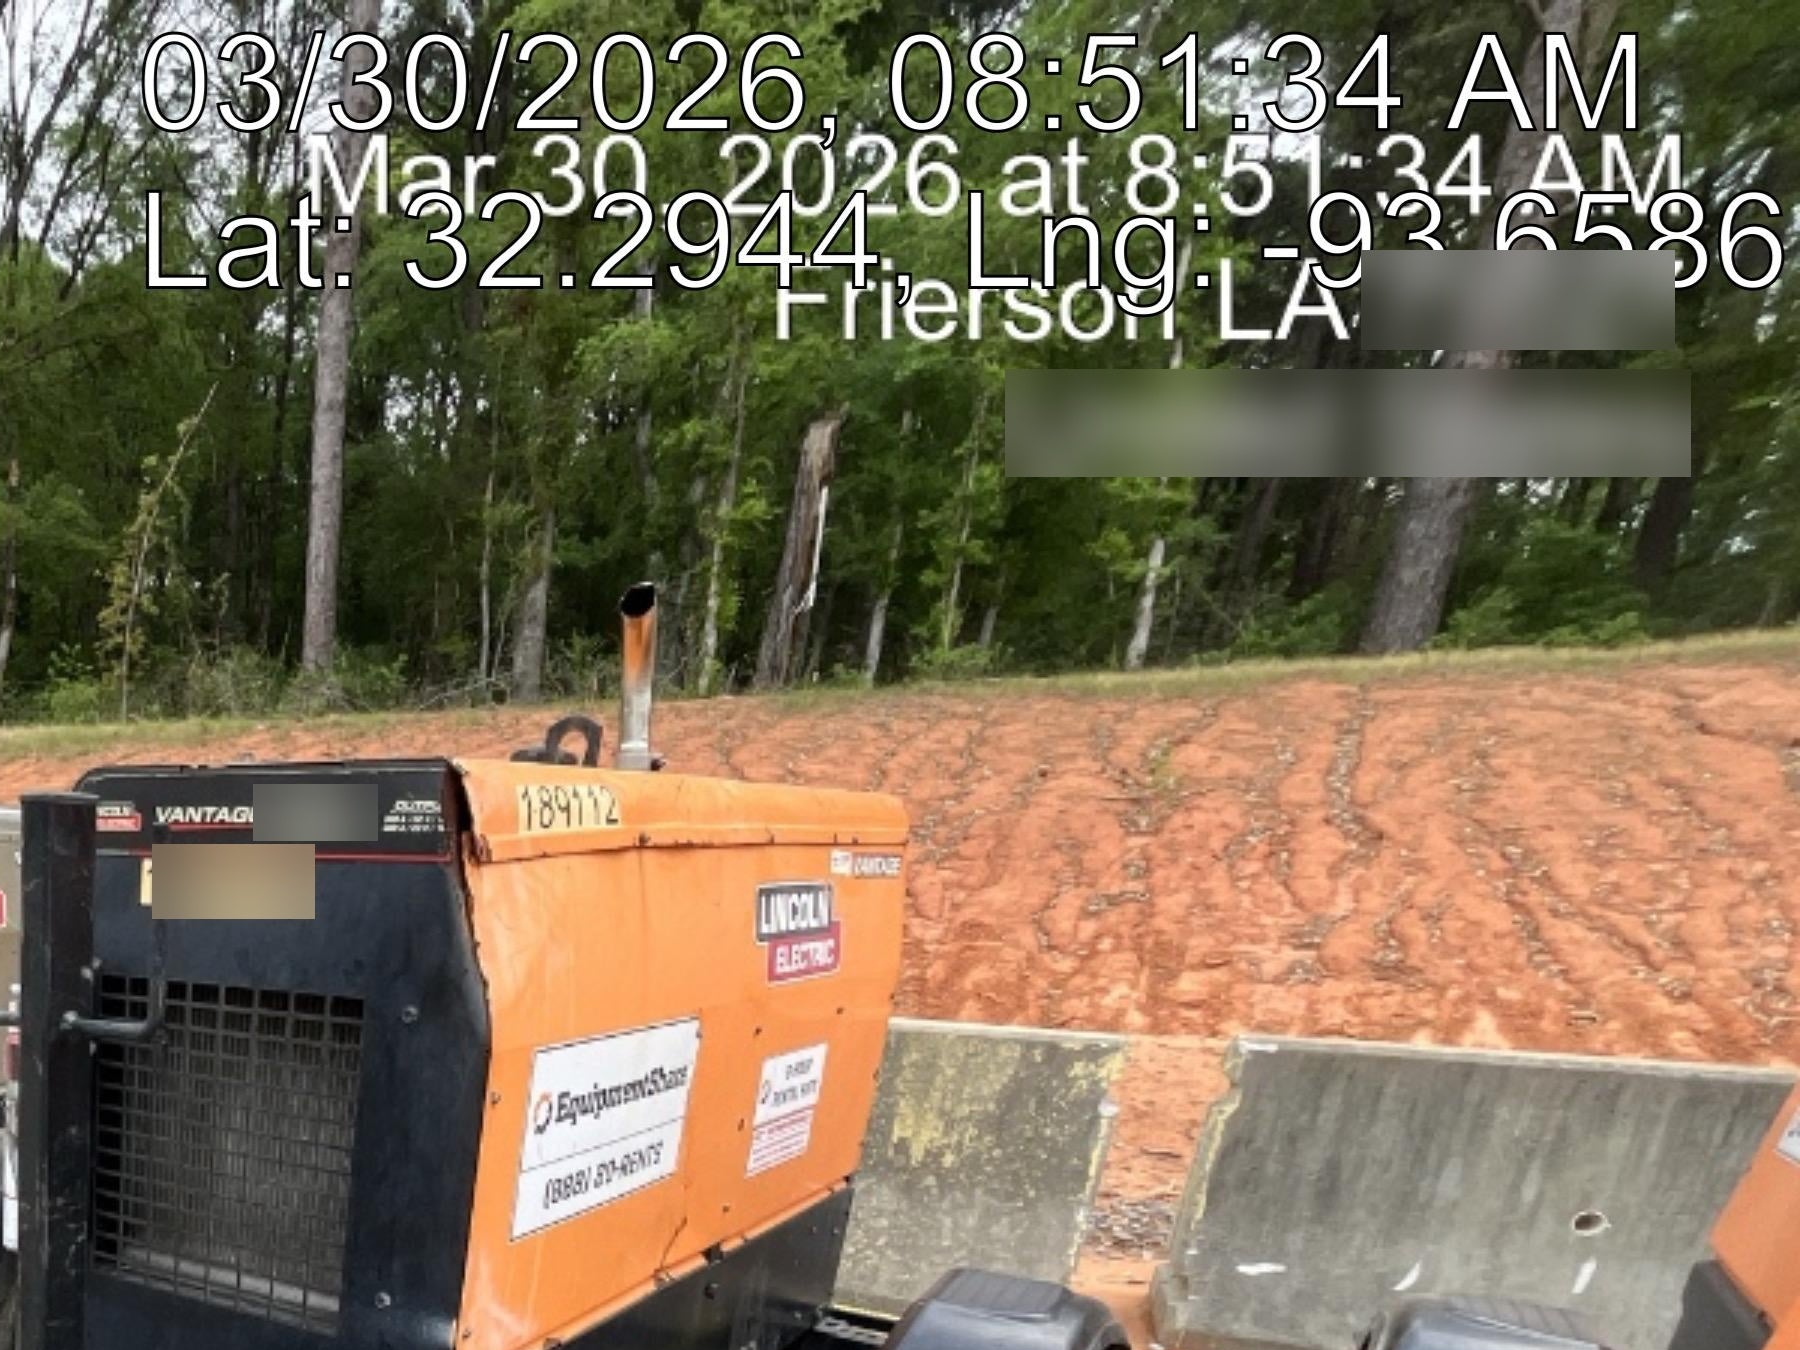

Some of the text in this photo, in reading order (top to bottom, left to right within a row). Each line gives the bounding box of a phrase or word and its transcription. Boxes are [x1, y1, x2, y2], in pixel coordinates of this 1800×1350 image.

[760, 890, 830, 934] LINCOLN
[775, 938, 836, 974] ELECTRIC
[554, 1065, 688, 1126] EquipmentShare
